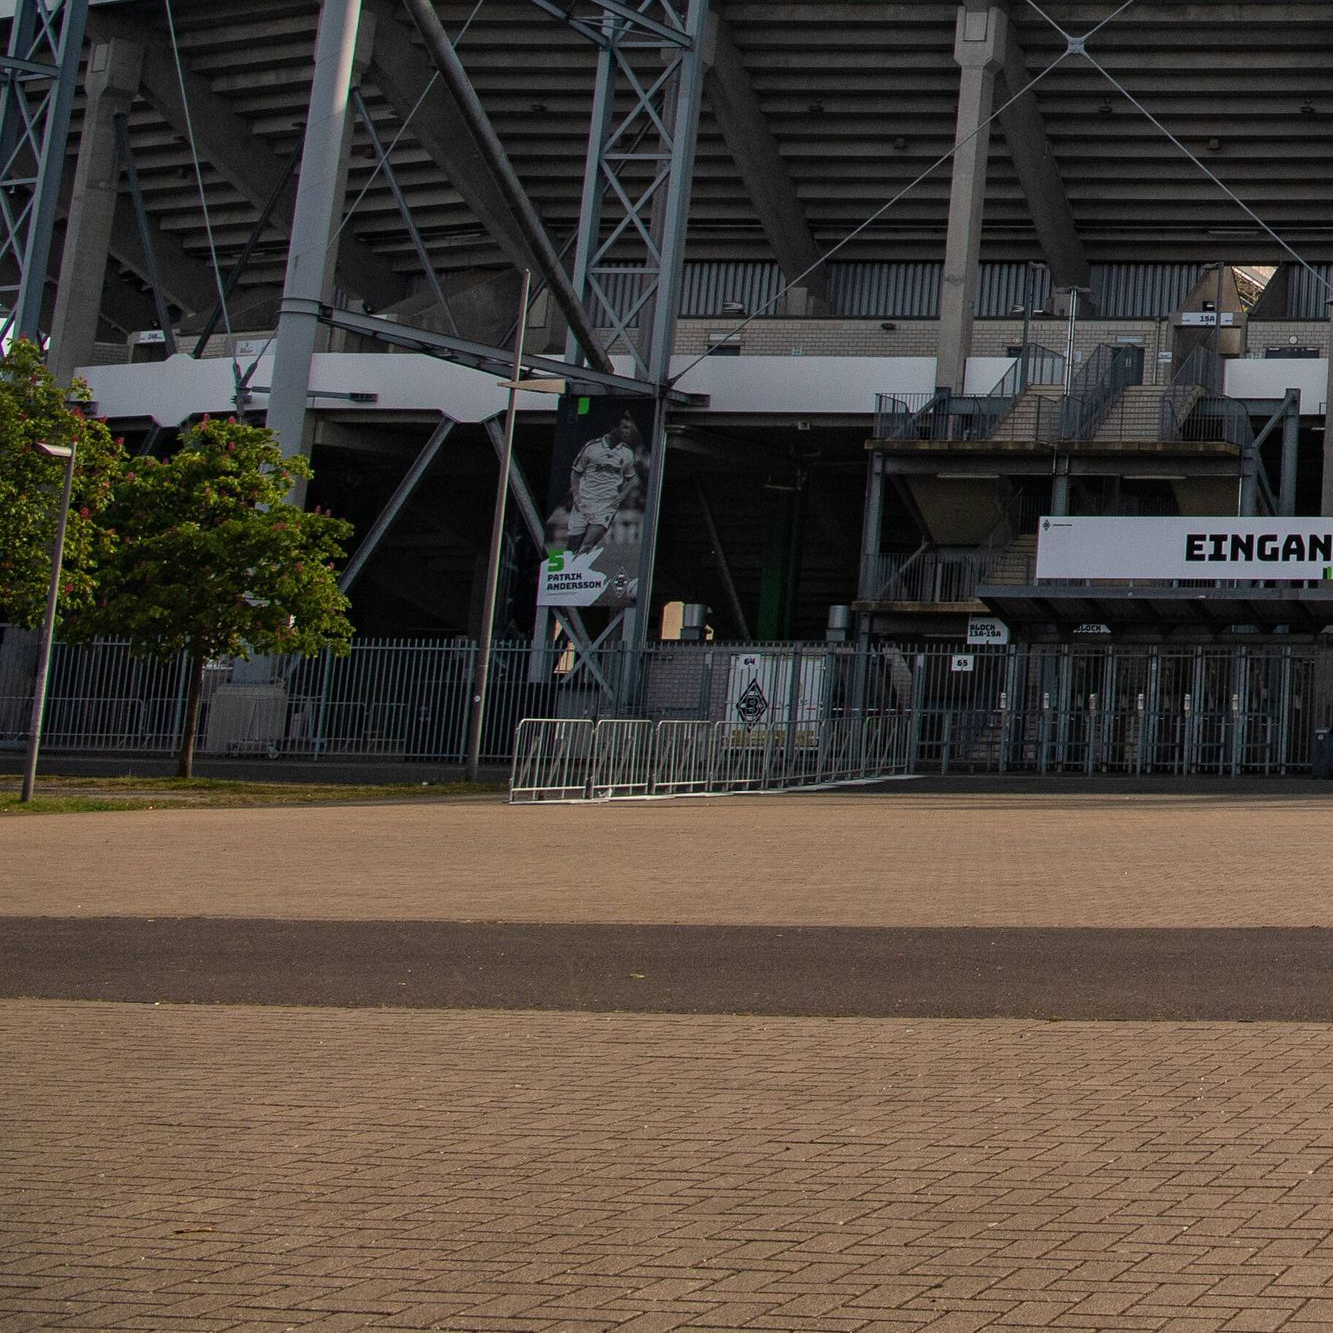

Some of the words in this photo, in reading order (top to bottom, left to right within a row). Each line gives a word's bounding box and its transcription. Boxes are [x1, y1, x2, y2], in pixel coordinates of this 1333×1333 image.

[548, 549, 565, 572] 5
[547, 573, 582, 581] PATRIK
[546, 581, 602, 591] ANDERSSON
